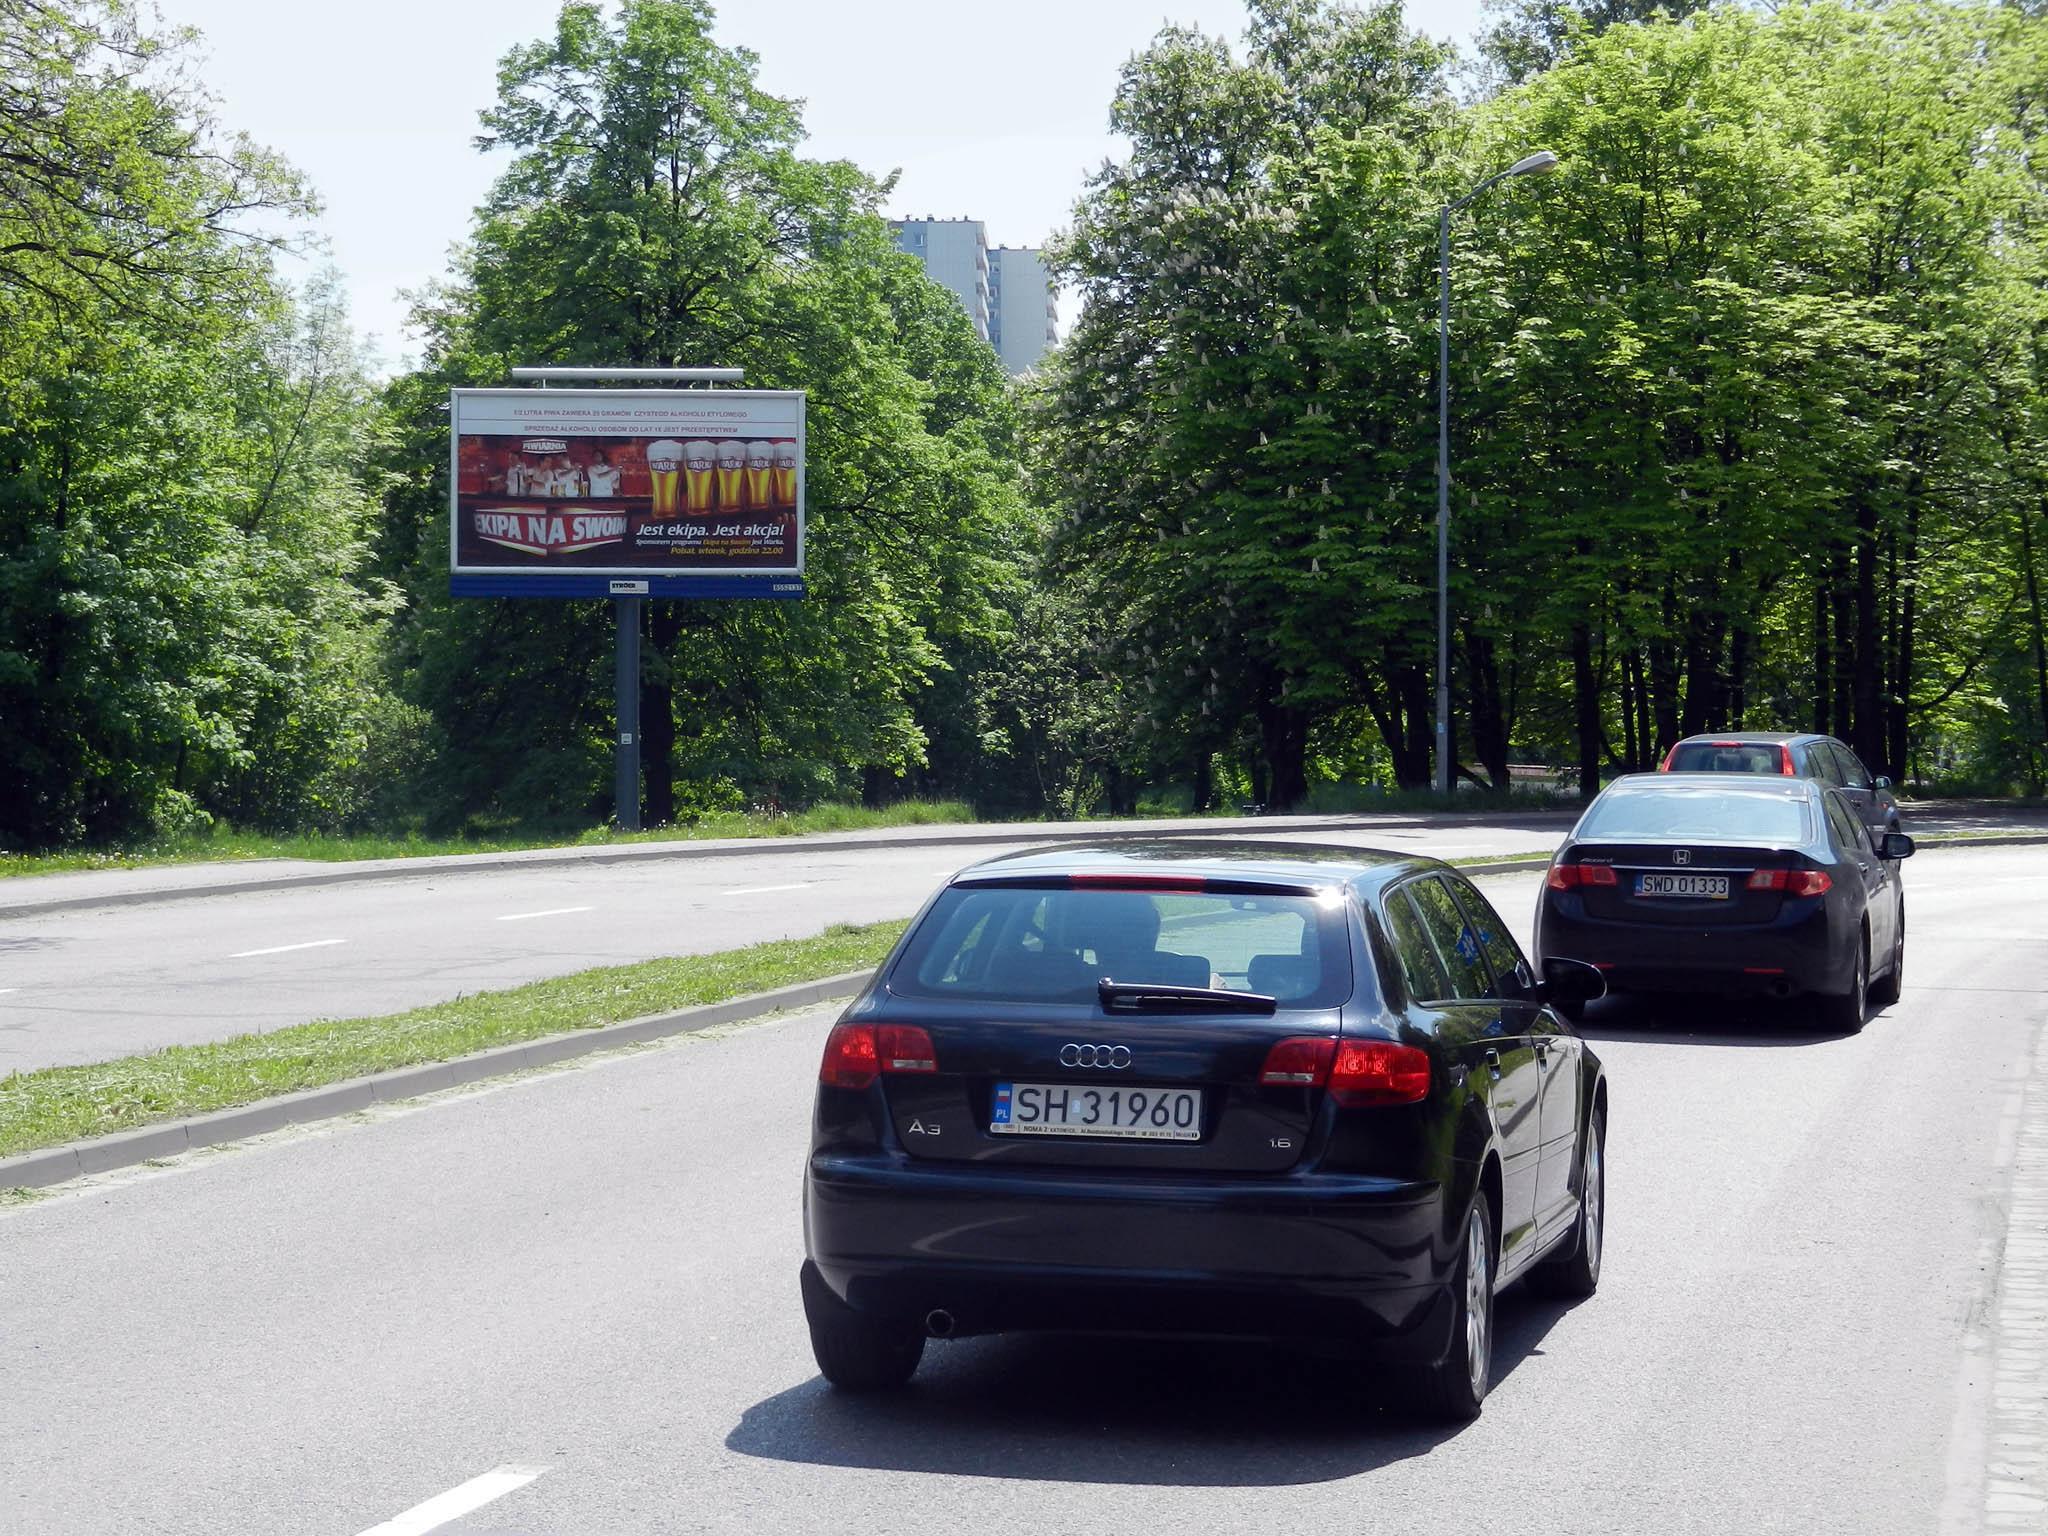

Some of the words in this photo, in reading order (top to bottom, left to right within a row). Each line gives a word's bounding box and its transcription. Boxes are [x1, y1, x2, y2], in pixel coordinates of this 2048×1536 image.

[562, 409, 591, 417] ZAWIERA
[707, 410, 748, 418] ETYLOWEGO
[474, 513, 522, 540] EKIPA
[527, 517, 567, 545] NA
[572, 516, 628, 541] SWOIM
[636, 523, 664, 536] Jest
[667, 523, 709, 539] ekipa.
[712, 524, 740, 536] Jest
[743, 523, 785, 539] akcja!
[728, 547, 760, 556] godzina
[761, 547, 784, 555] 22.00
[1643, 875, 1674, 893] SWD
[1678, 877, 1728, 894] 01333
[995, 1109, 1009, 1119] PL
[1017, 1088, 1069, 1123] SH
[1081, 1090, 1194, 1128] 31960
[909, 1118, 941, 1135] A3
[1269, 1138, 1291, 1148] 1.6
